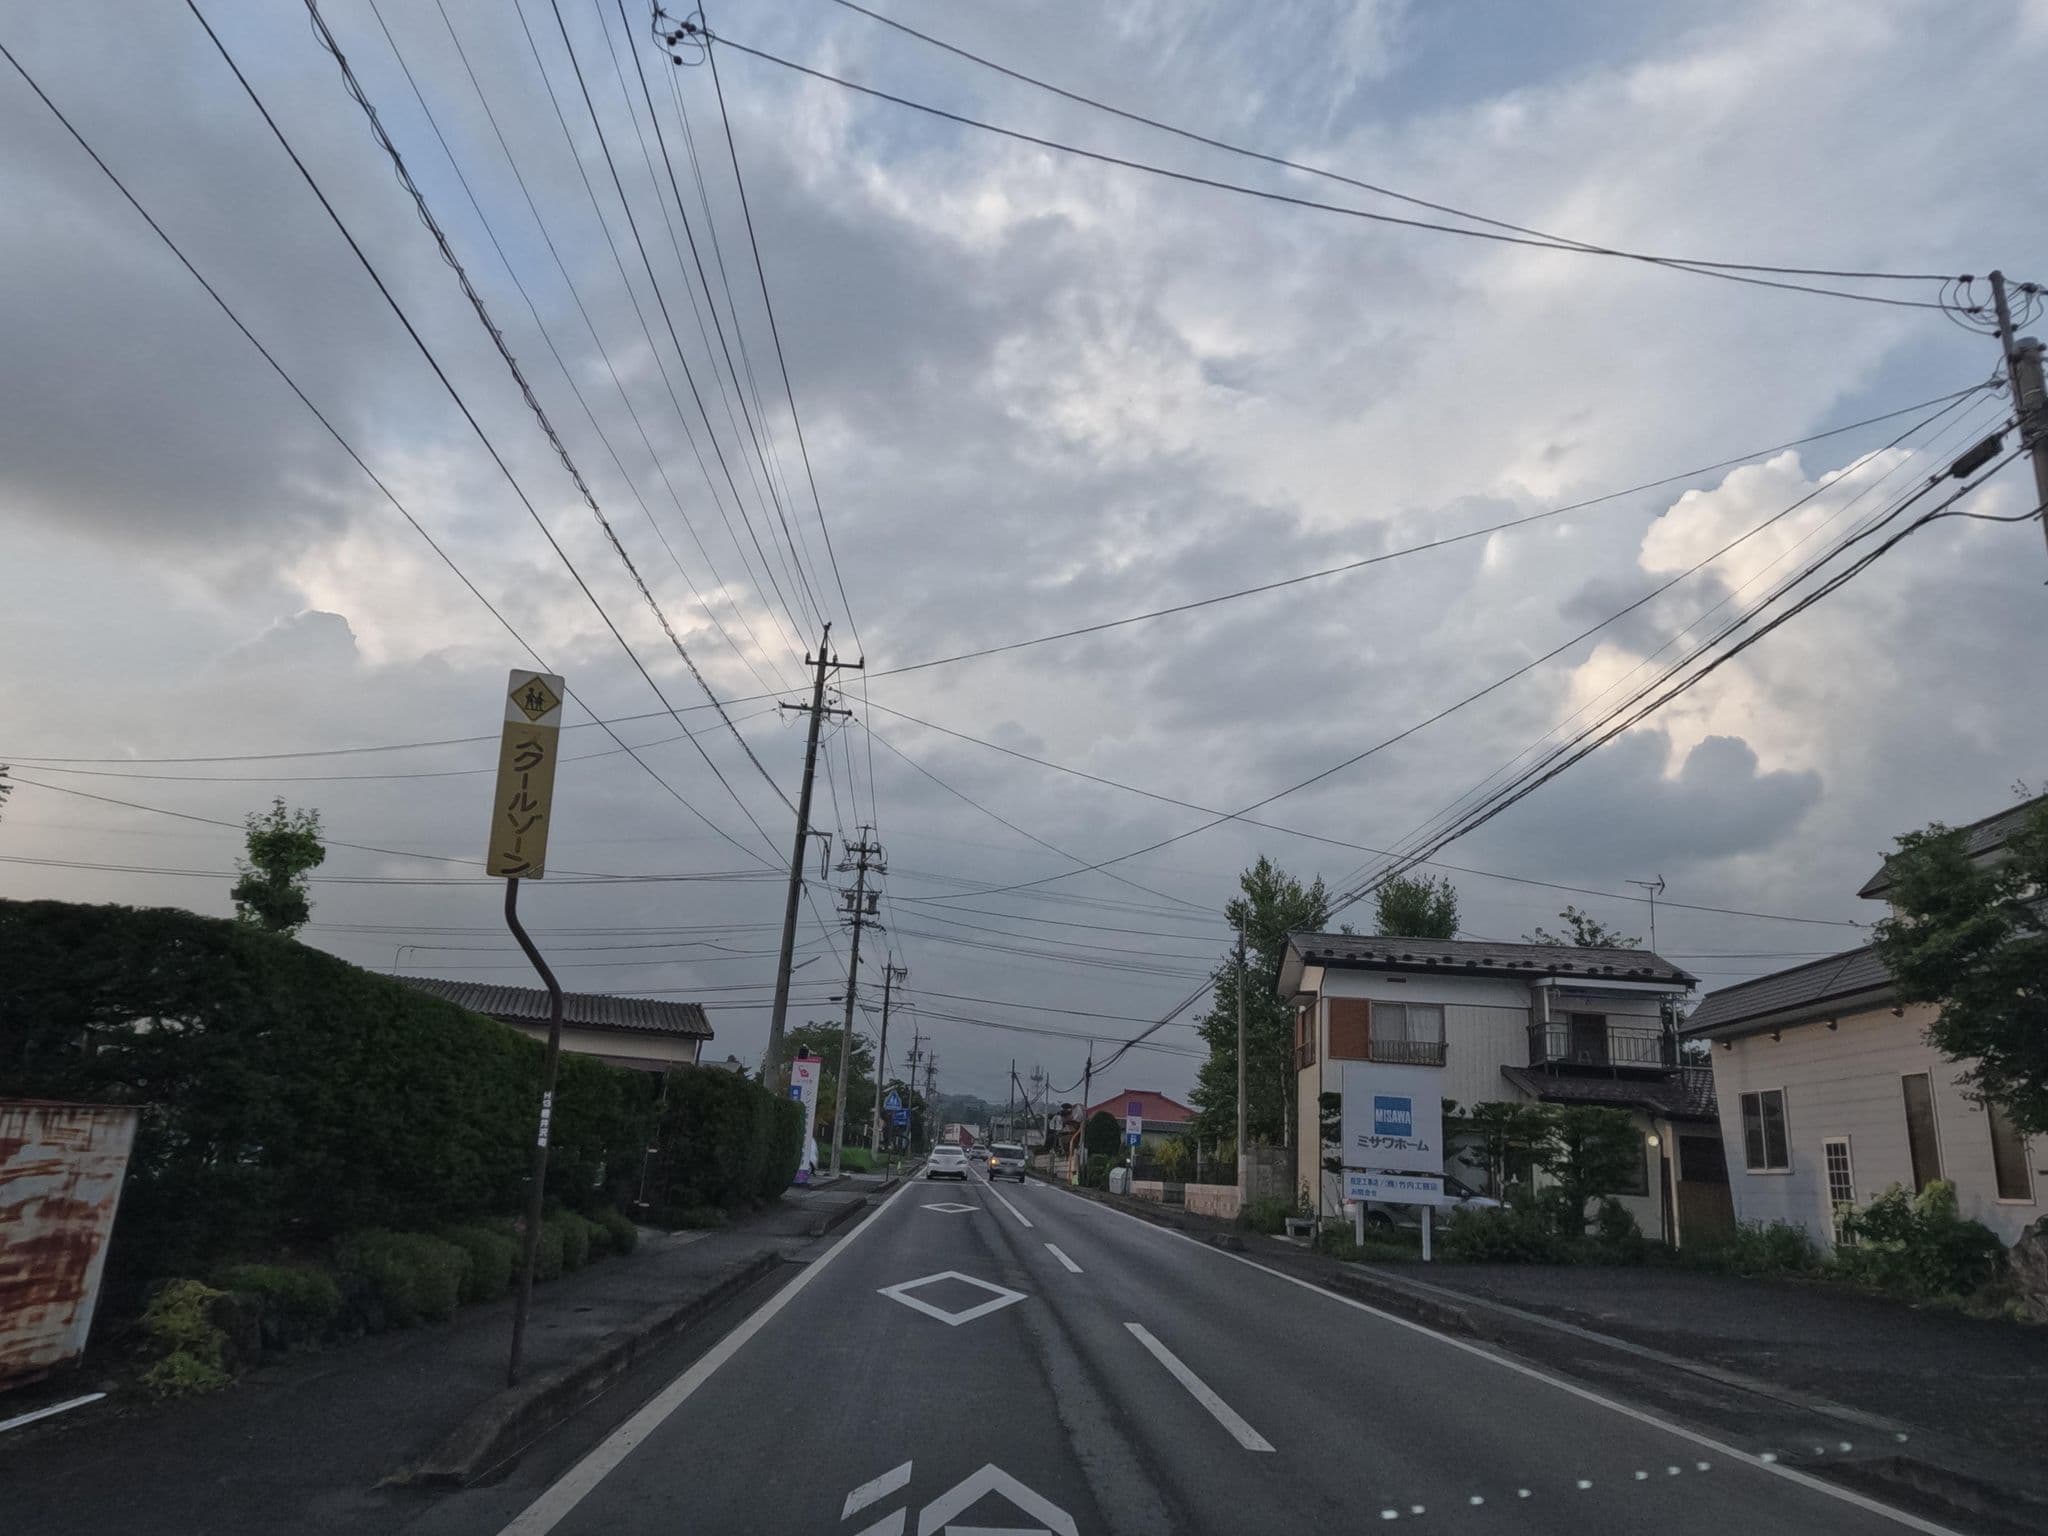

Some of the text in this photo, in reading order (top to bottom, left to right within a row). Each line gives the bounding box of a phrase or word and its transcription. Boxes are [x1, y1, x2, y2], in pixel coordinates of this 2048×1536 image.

[1375, 1109, 1411, 1124] MISAWA
[1357, 1136, 1429, 1151] ミサワホーム
